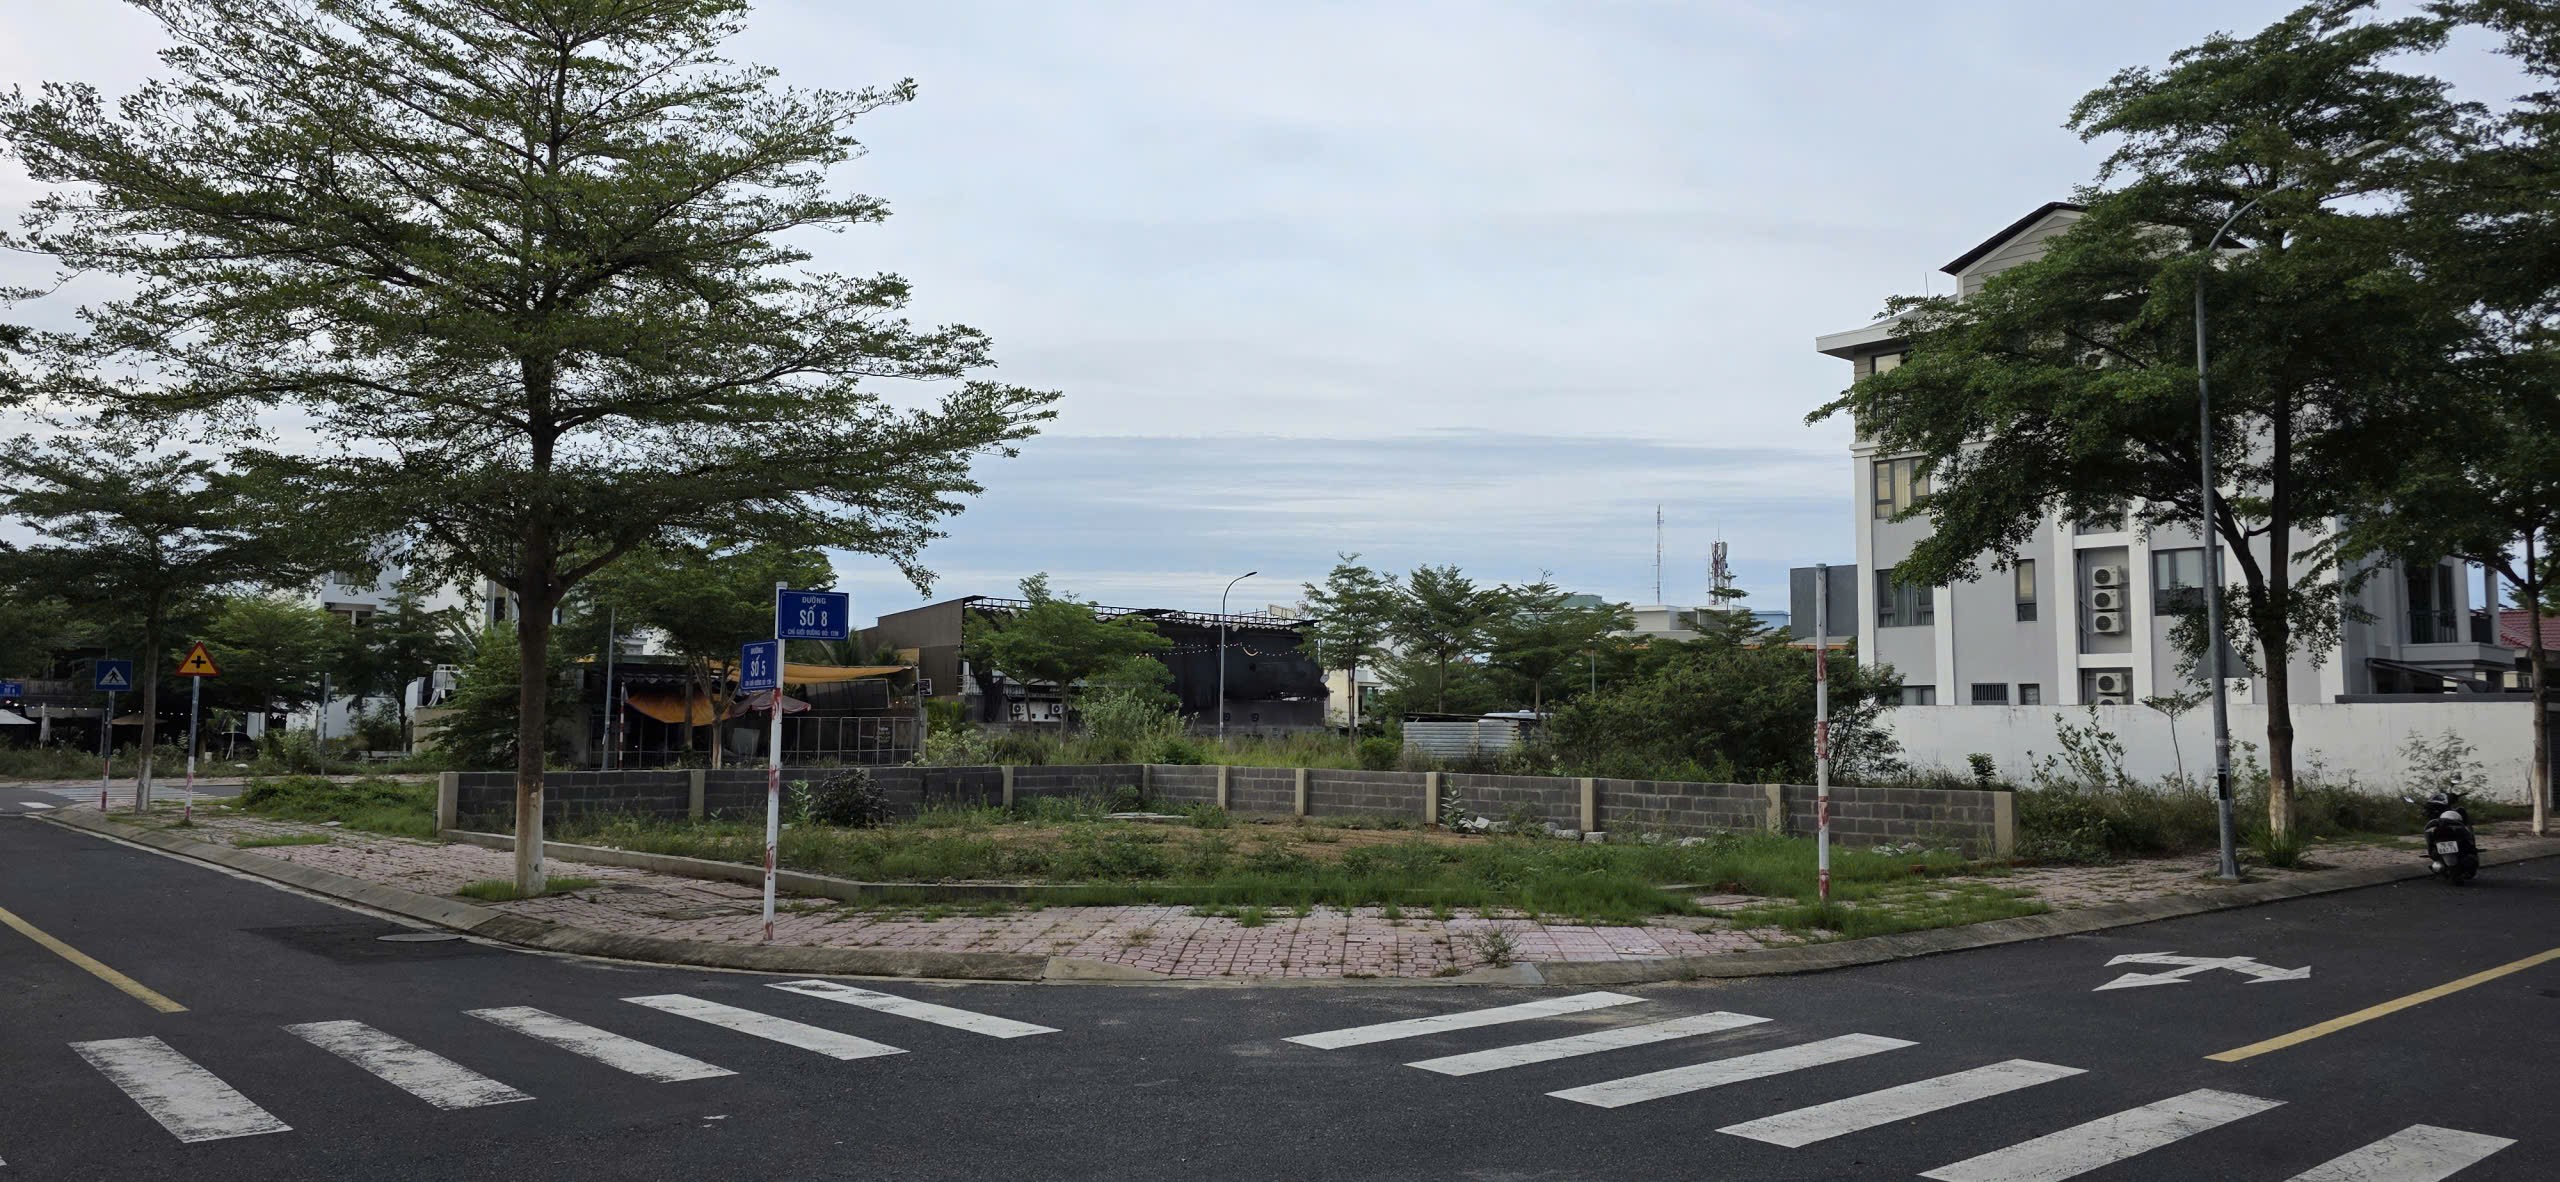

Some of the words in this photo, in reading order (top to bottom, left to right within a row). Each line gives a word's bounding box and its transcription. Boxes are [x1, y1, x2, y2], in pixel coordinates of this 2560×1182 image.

[800, 604, 816, 626] SỐ
[821, 611, 828, 627] 8
[750, 655, 760, 677] SỐ
[761, 660, 766, 676] 5
